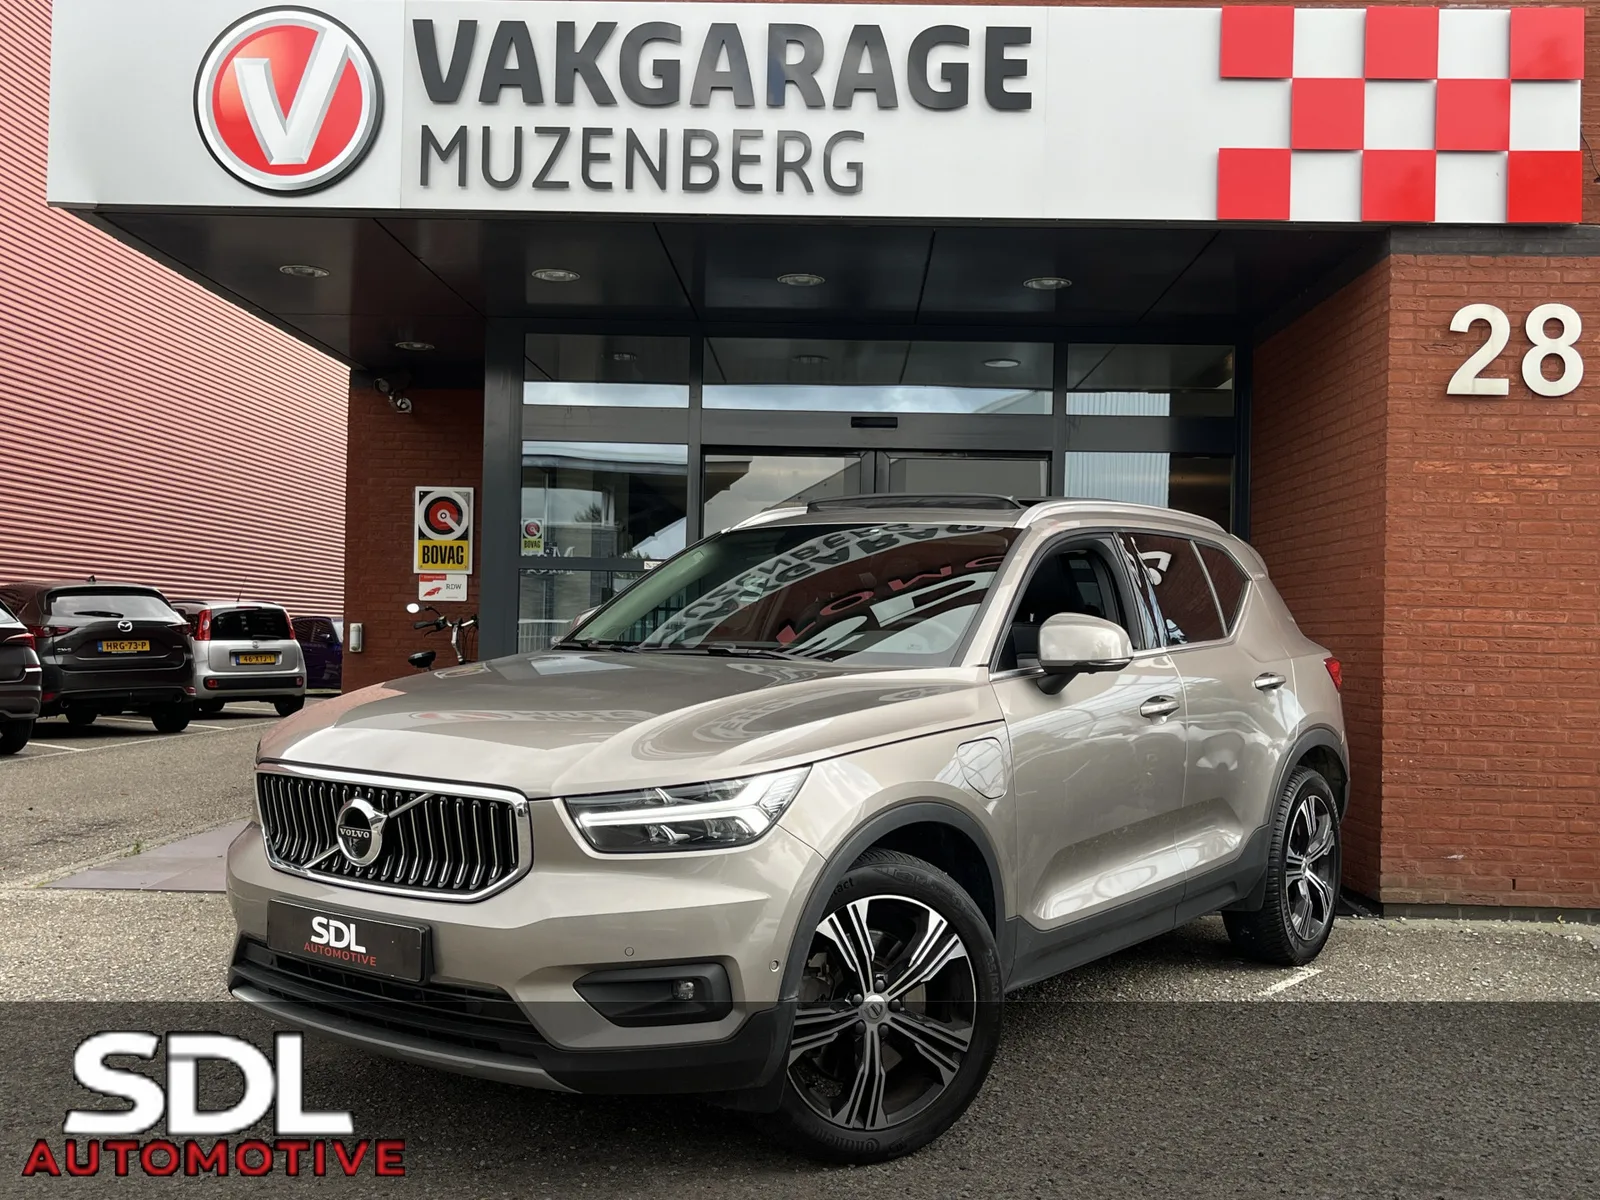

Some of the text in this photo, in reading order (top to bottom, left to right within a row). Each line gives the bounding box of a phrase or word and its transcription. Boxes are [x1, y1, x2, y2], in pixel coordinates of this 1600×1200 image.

[412, 18, 1033, 112] VAKGARAGE
[233, 20, 349, 166] V
[419, 124, 865, 195] MUZENBERG
[1446, 303, 1584, 398] 28
[421, 545, 464, 565] BOVAG
[523, 540, 541, 549] BOVAG
[106, 641, 147, 650] HRG-73-P
[339, 827, 370, 839] VOLVO
[310, 916, 367, 954] SDL
[303, 942, 377, 967] AUTOMOTIVE
